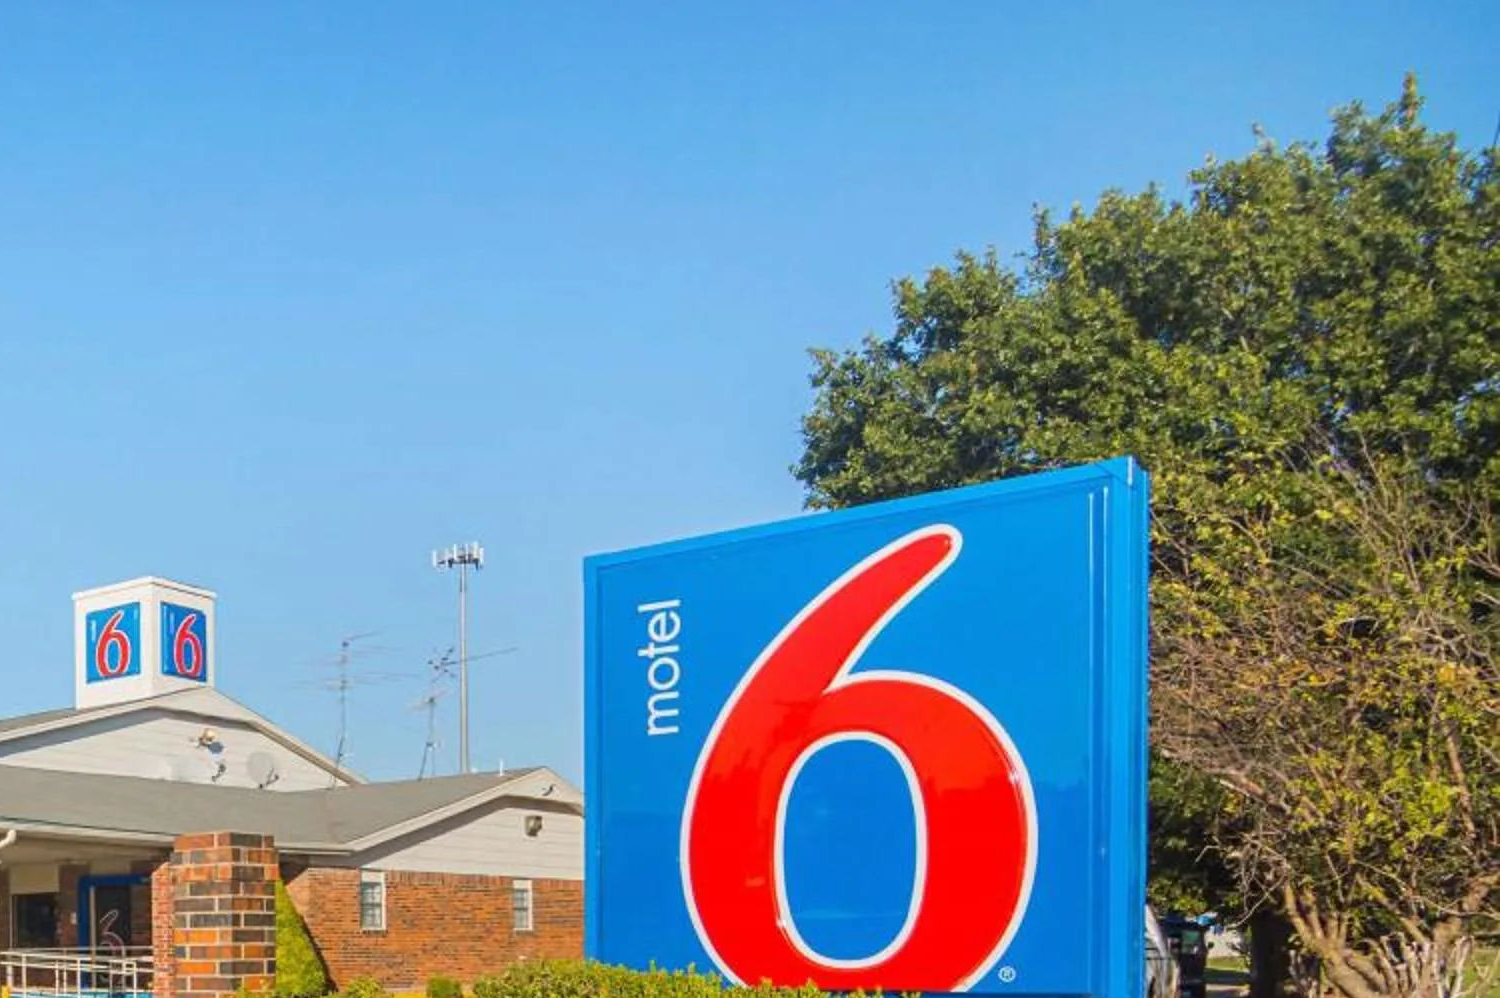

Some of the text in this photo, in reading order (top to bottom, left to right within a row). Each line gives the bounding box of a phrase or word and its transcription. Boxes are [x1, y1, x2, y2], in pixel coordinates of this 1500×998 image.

[95, 609, 131, 678] 6
[173, 612, 203, 678] 6
[637, 523, 1039, 992] motel 6
